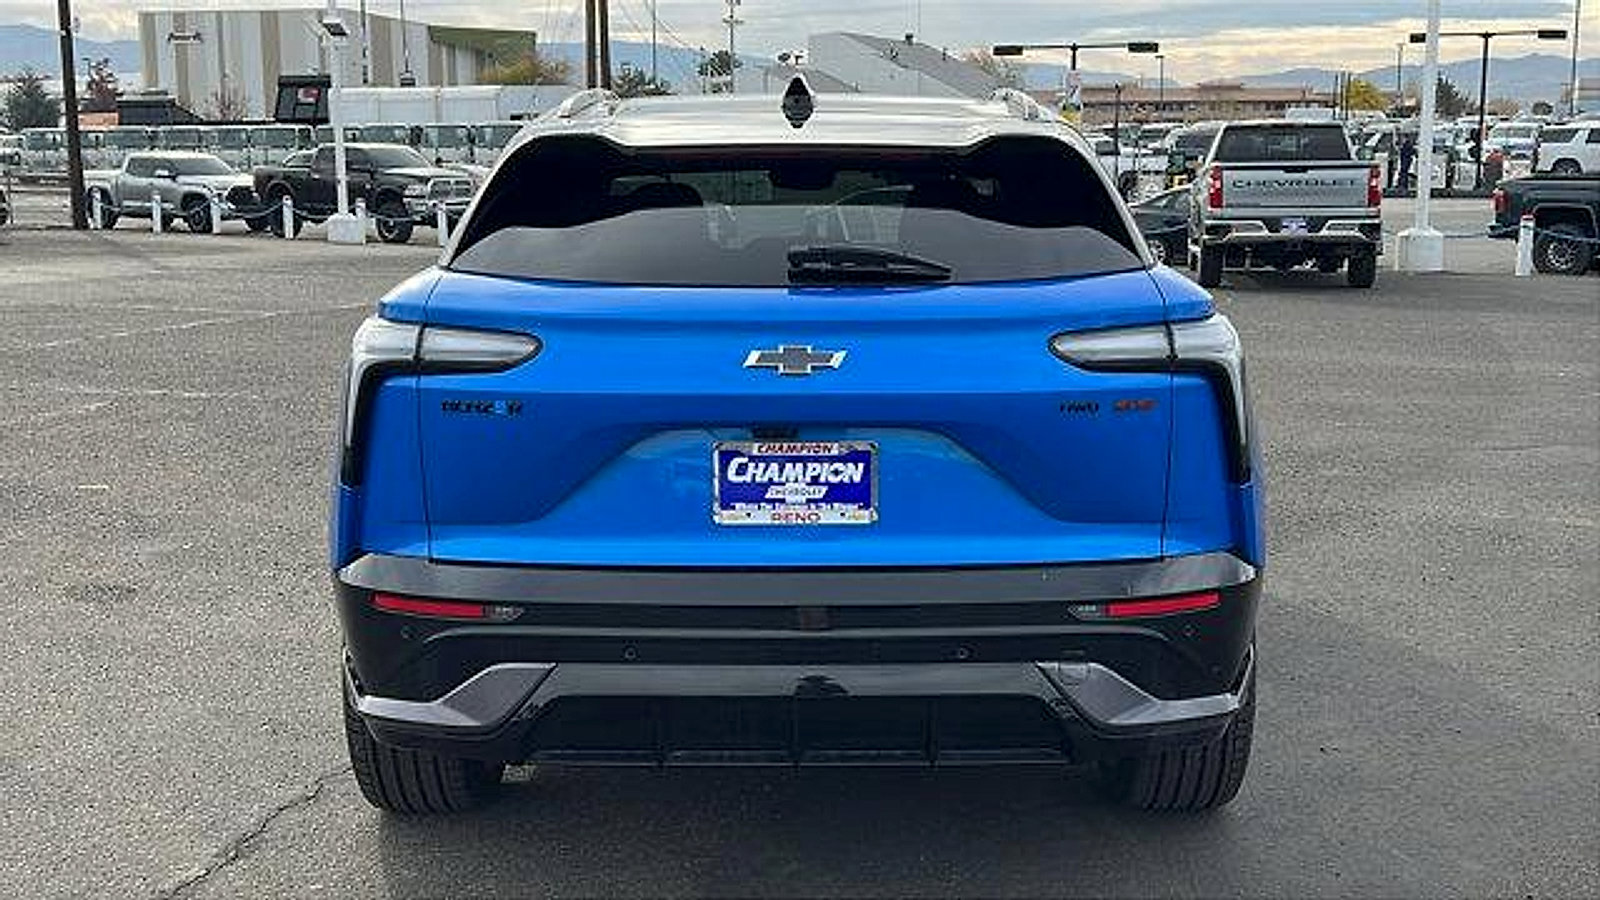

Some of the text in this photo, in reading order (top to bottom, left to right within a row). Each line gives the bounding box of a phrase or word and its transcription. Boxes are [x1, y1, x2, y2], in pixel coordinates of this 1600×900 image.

[1233, 179, 1357, 190] CHEVROLET
[757, 442, 834, 455] CHAMPION
[727, 457, 865, 483] CHAMPION
[770, 512, 822, 524] RENO
